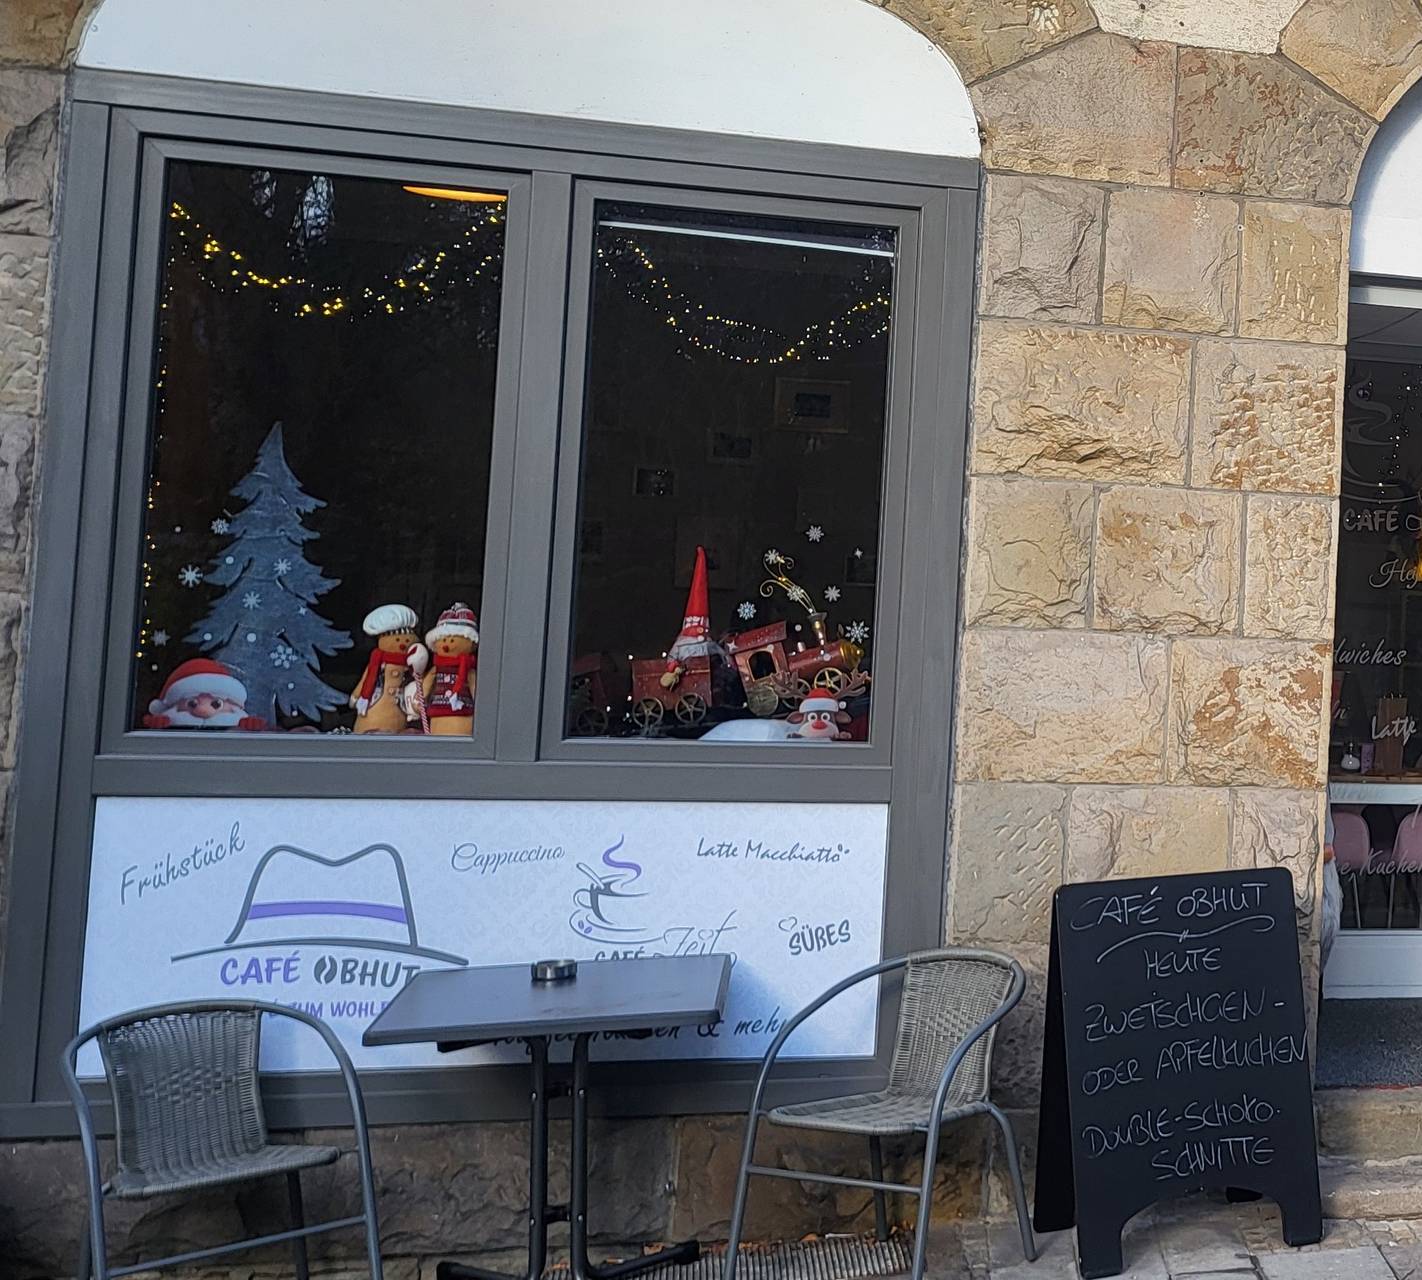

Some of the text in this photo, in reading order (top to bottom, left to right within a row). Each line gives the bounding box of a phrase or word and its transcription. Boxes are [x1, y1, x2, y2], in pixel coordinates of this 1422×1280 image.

[1343, 506, 1399, 532] CAFÉ
[1372, 715, 1416, 743] Latte
[120, 821, 247, 905] Frühstück
[452, 842, 566, 875] Cappuccino
[697, 837, 738, 858] Latte
[1070, 883, 1268, 931] CAFÉ OBHUT
[220, 951, 300, 985] CAFÉ
[1144, 947, 1222, 980] HEUTE
[1081, 1030, 1308, 1096] ODER APFELKUCHEN
[1152, 1136, 1274, 1180] SCHNITTE
